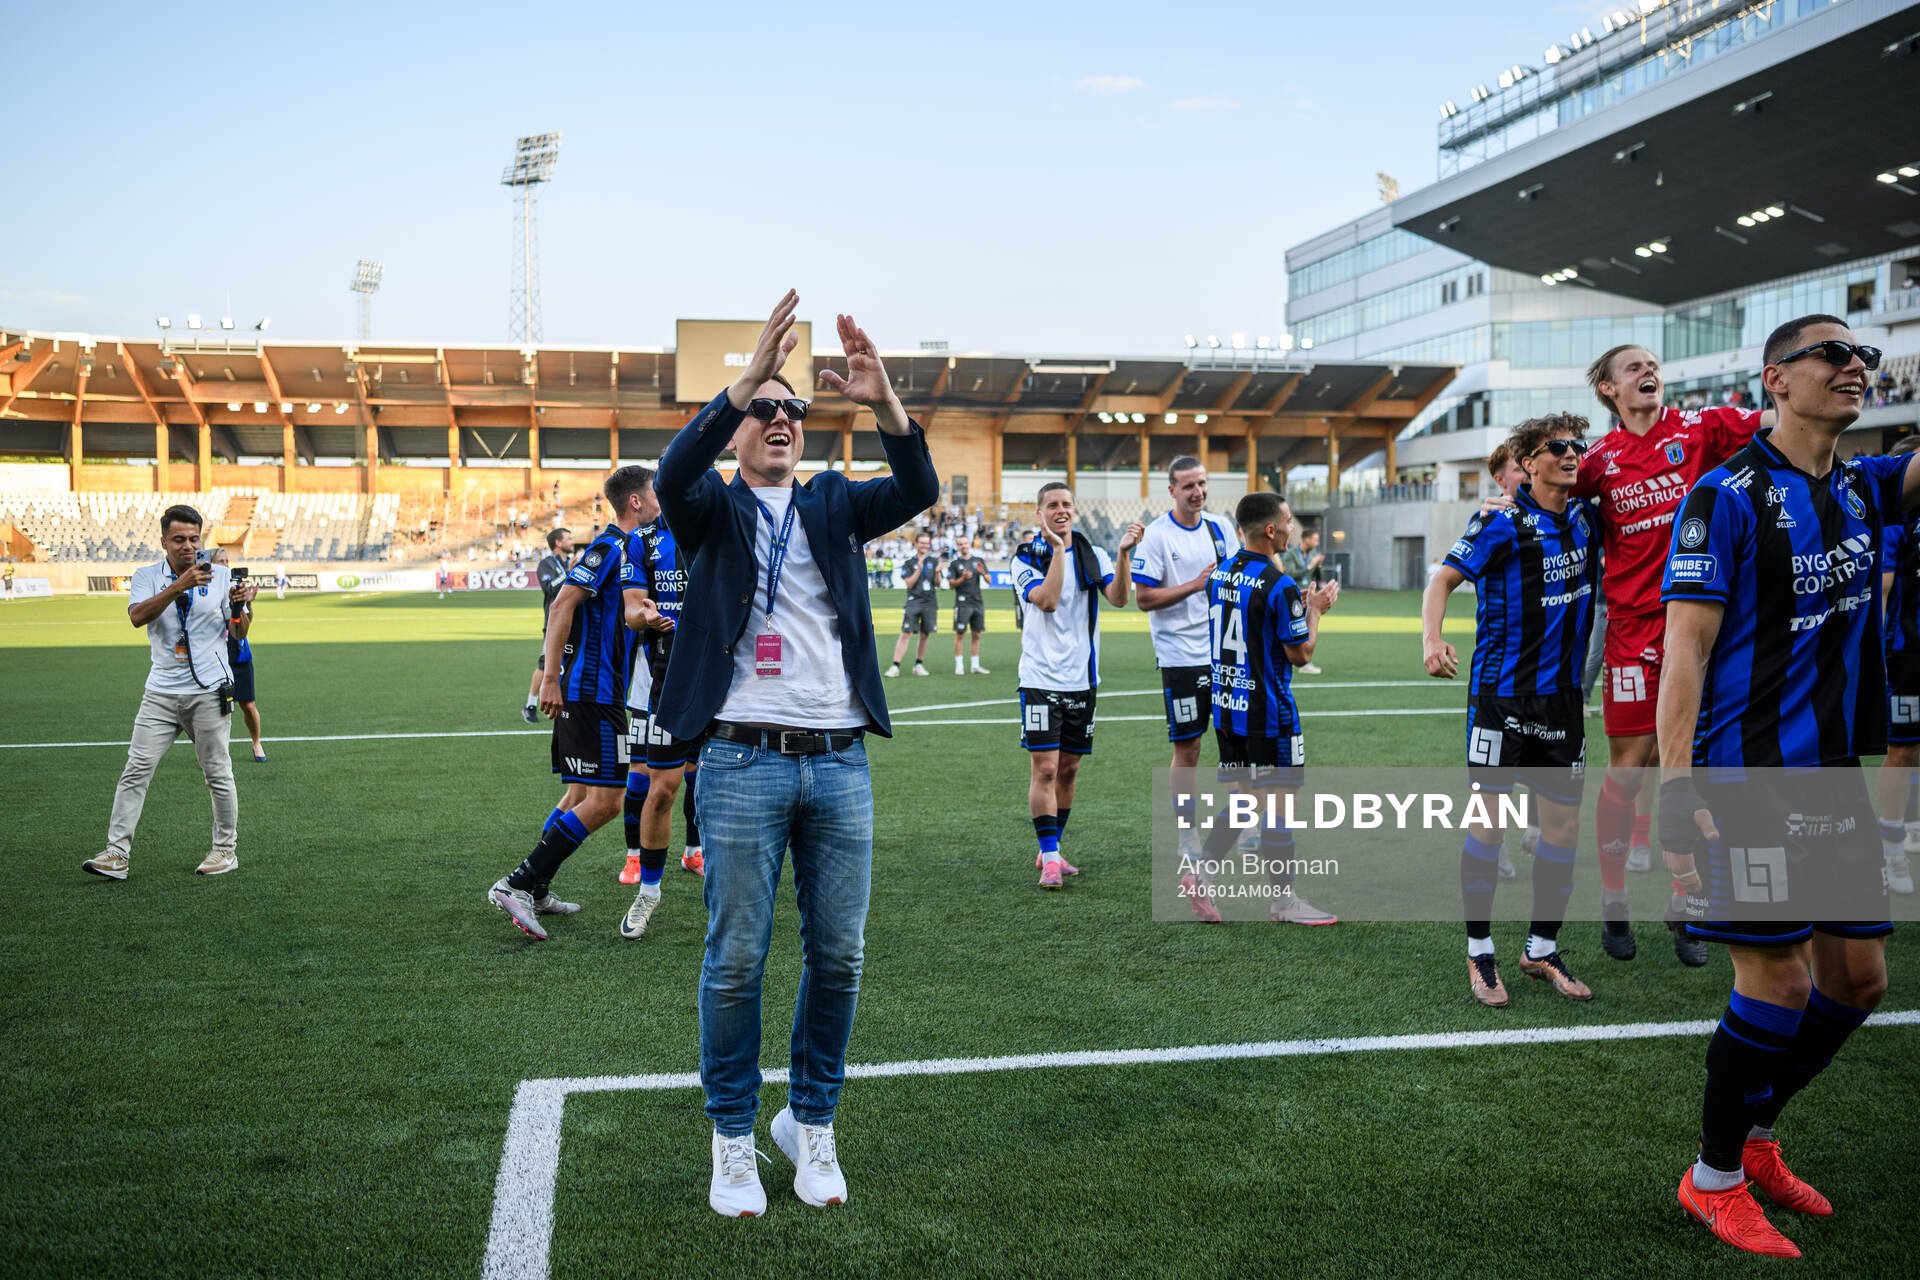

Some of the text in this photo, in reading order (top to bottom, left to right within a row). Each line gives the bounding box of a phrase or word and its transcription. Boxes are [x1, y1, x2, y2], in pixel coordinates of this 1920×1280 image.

[1610, 481, 1645, 501] BYGG
[1615, 484, 1688, 514] CONSTRUCT
[1621, 512, 1675, 536] TOYO TIR
[1776, 521, 1797, 529] SELECT
[1542, 552, 1570, 570] BYGG
[1671, 559, 1713, 571] UNIBET
[468, 570, 529, 589] BYGG
[654, 570, 683, 581] BYGG
[1243, 575, 1265, 589] TAK
[655, 581, 688, 592] CONST
[1218, 586, 1241, 604] WALTA
[1540, 592, 1573, 608] TOYO
[1209, 604, 1248, 665] 14
[1212, 673, 1256, 691] ELLNESS
[1522, 725, 1566, 741] BILFORUM
